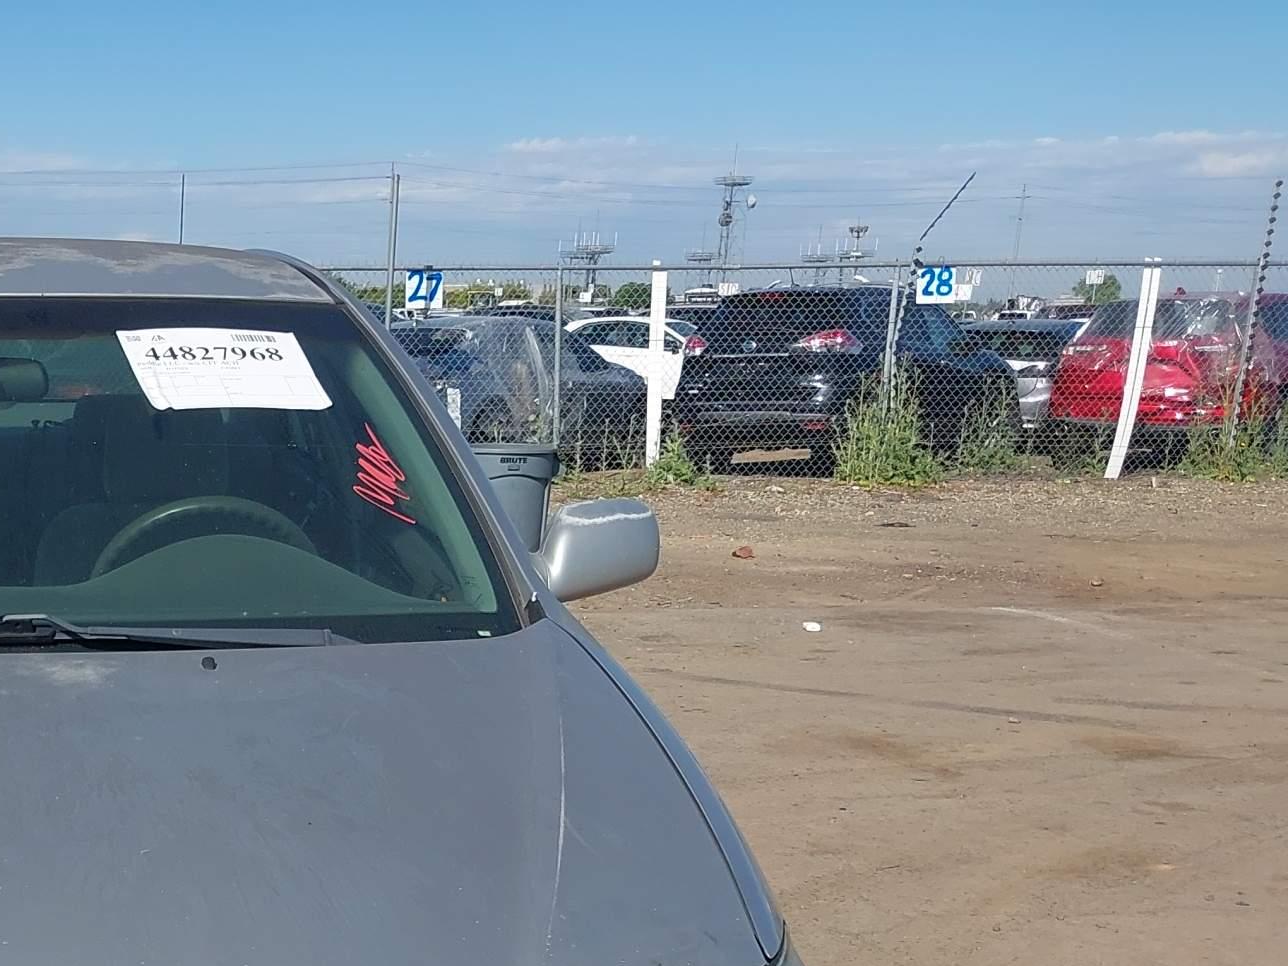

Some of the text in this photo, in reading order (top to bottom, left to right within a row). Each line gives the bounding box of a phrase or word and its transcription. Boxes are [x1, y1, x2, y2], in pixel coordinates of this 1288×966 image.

[408, 268, 443, 303] 27
[920, 266, 953, 296] 28
[144, 345, 284, 361] 44827968
